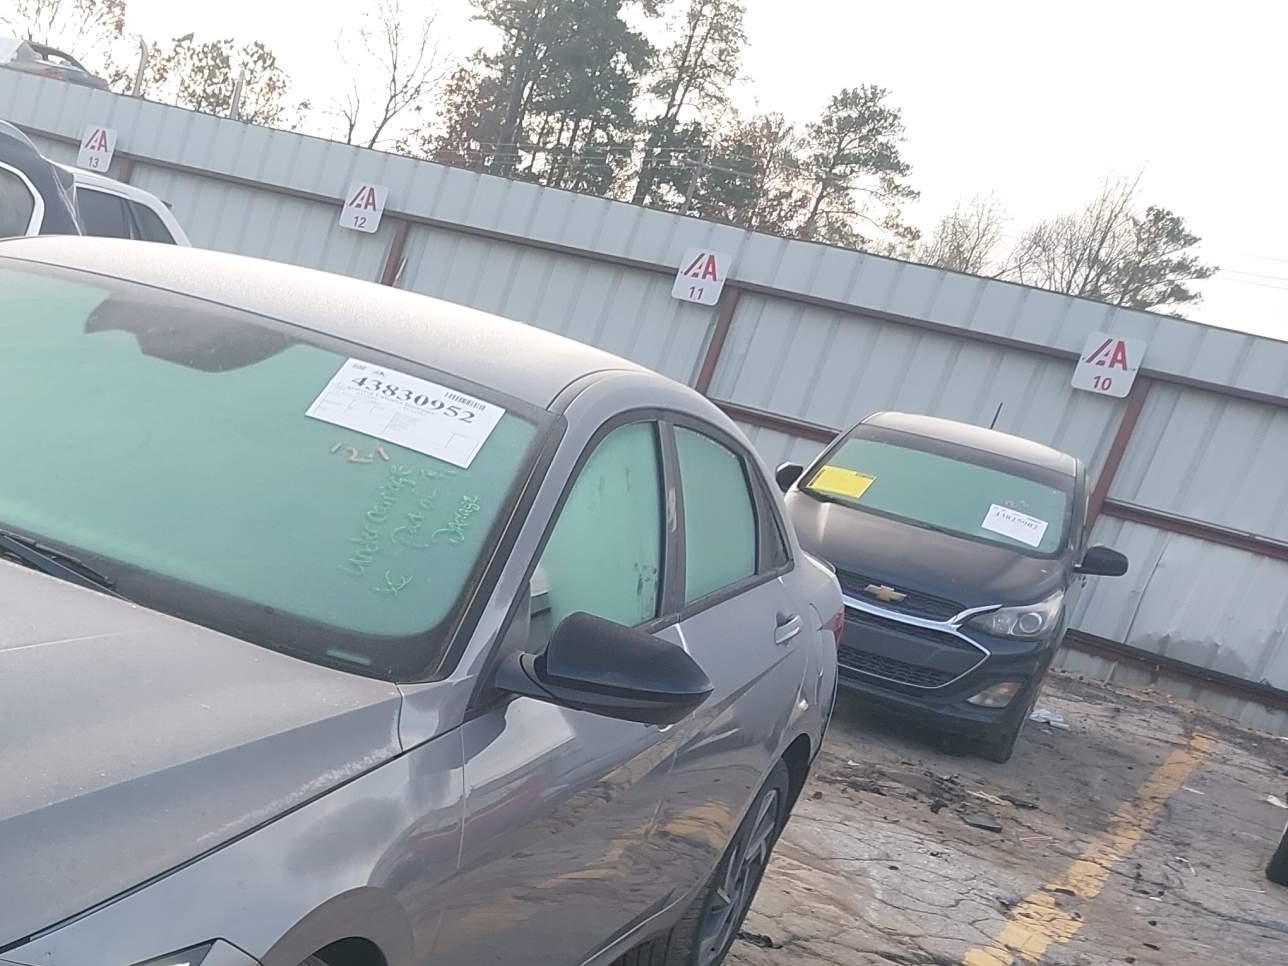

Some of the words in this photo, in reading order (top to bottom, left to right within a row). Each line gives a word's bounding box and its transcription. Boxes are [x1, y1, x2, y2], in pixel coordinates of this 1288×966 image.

[88, 156, 99, 168] 13
[354, 216, 367, 228] 12
[689, 286, 703, 300] 11
[1094, 375, 1112, 391] 10
[351, 376, 476, 424] 43830952
